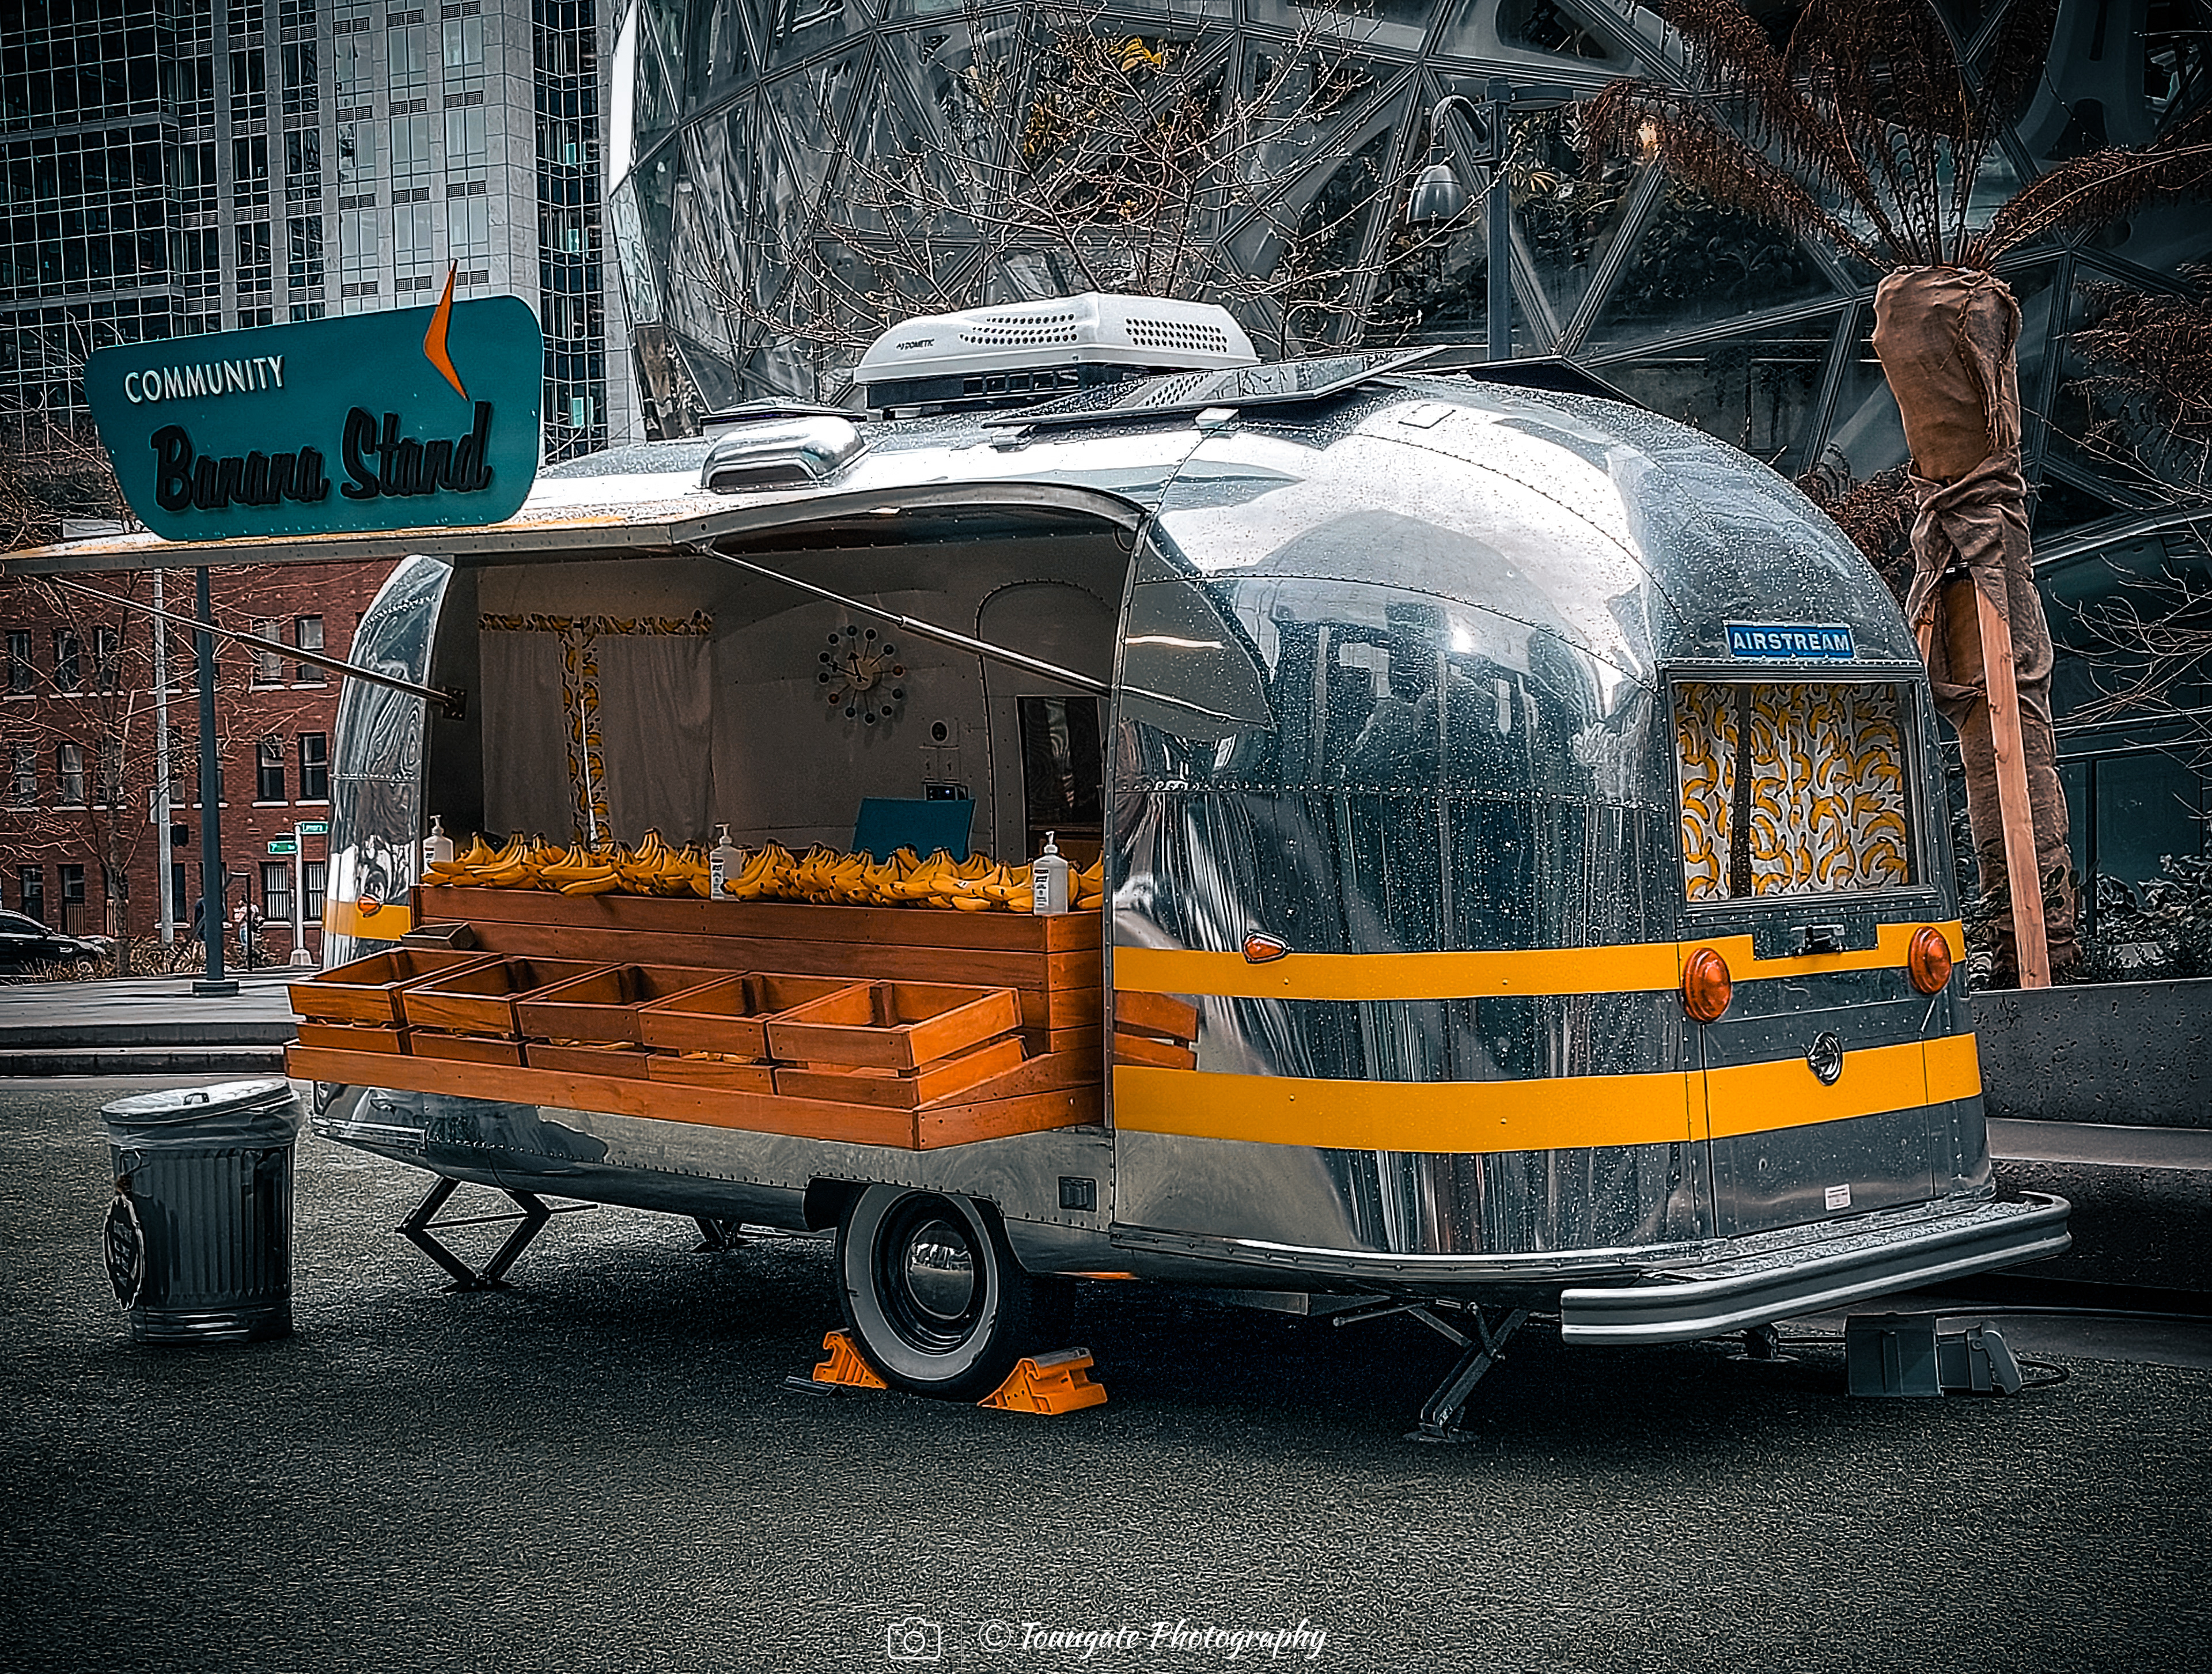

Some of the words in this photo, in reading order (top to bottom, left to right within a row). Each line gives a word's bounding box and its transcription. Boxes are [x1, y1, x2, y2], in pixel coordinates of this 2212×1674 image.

[125, 355, 284, 403] COMMUNITY
[150, 424, 330, 512] Banana
[340, 401, 493, 500] Stand
[1734, 633, 1849, 651] AIRSTREAM
